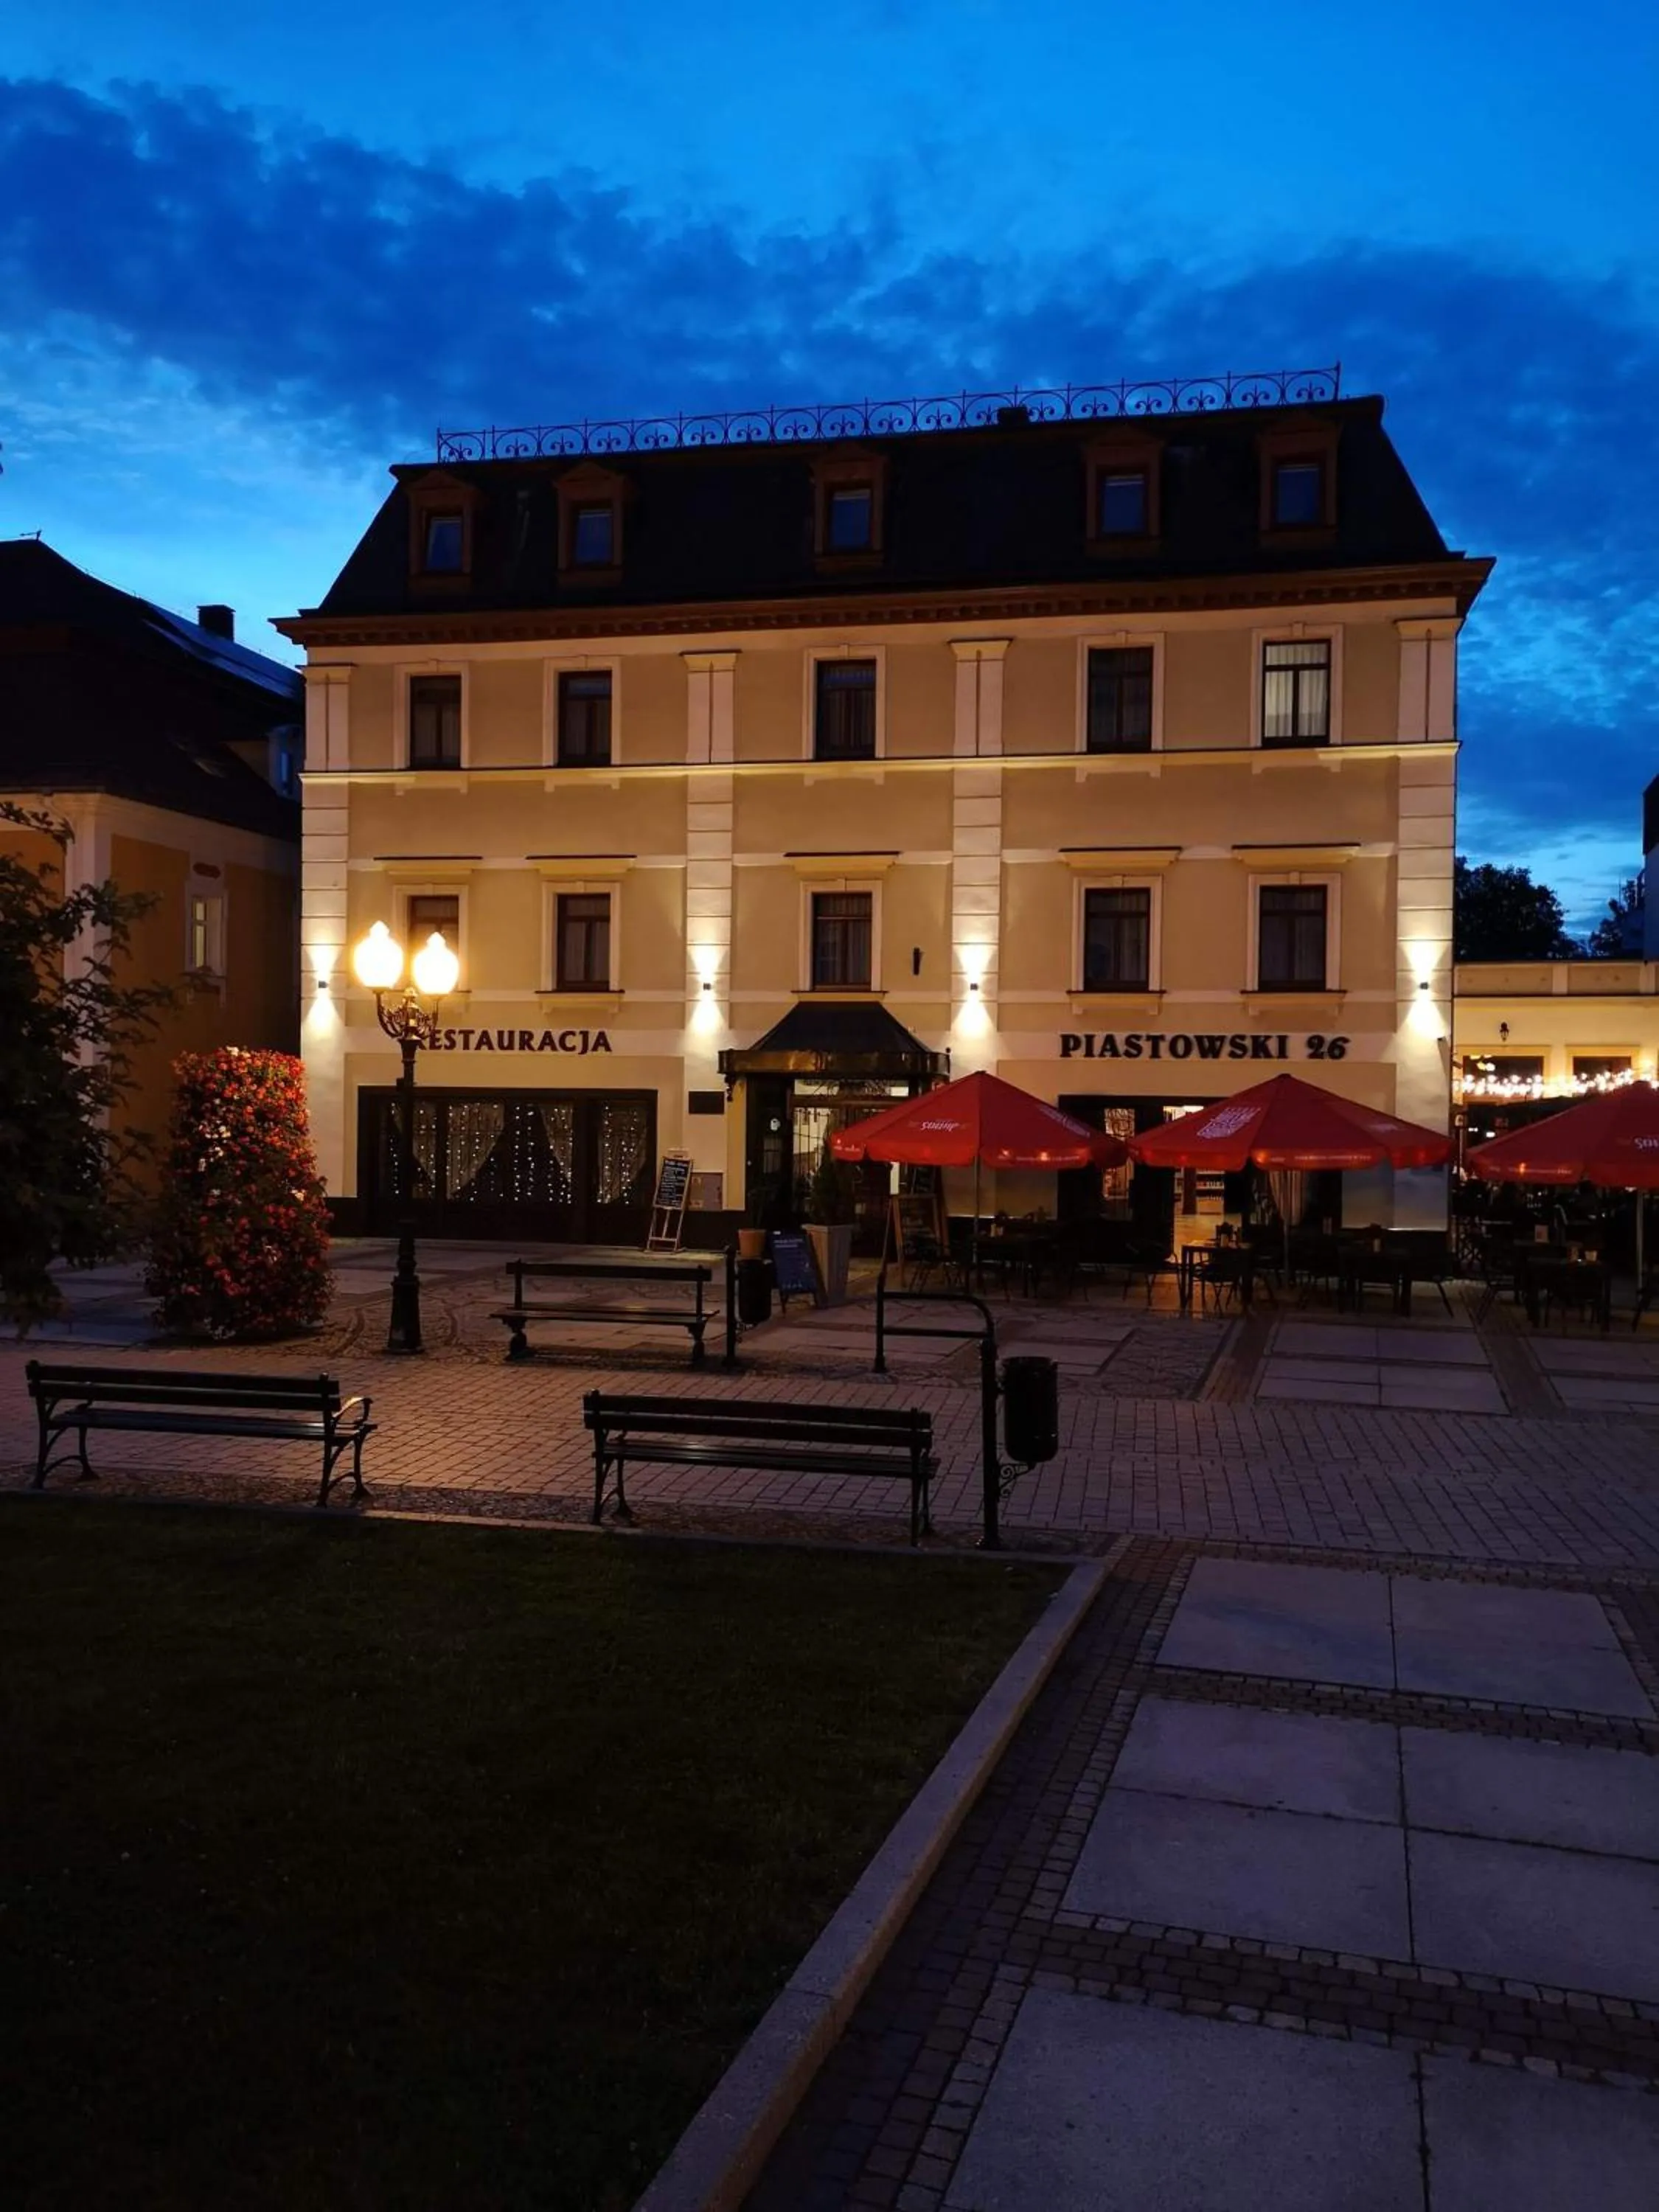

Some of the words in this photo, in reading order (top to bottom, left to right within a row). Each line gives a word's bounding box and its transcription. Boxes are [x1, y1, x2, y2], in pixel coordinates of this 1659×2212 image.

[418, 1029, 612, 1055] ESTAURACJA
[1060, 1034, 1289, 1060] PIASTOWSKI
[1307, 1034, 1351, 1060] 26
